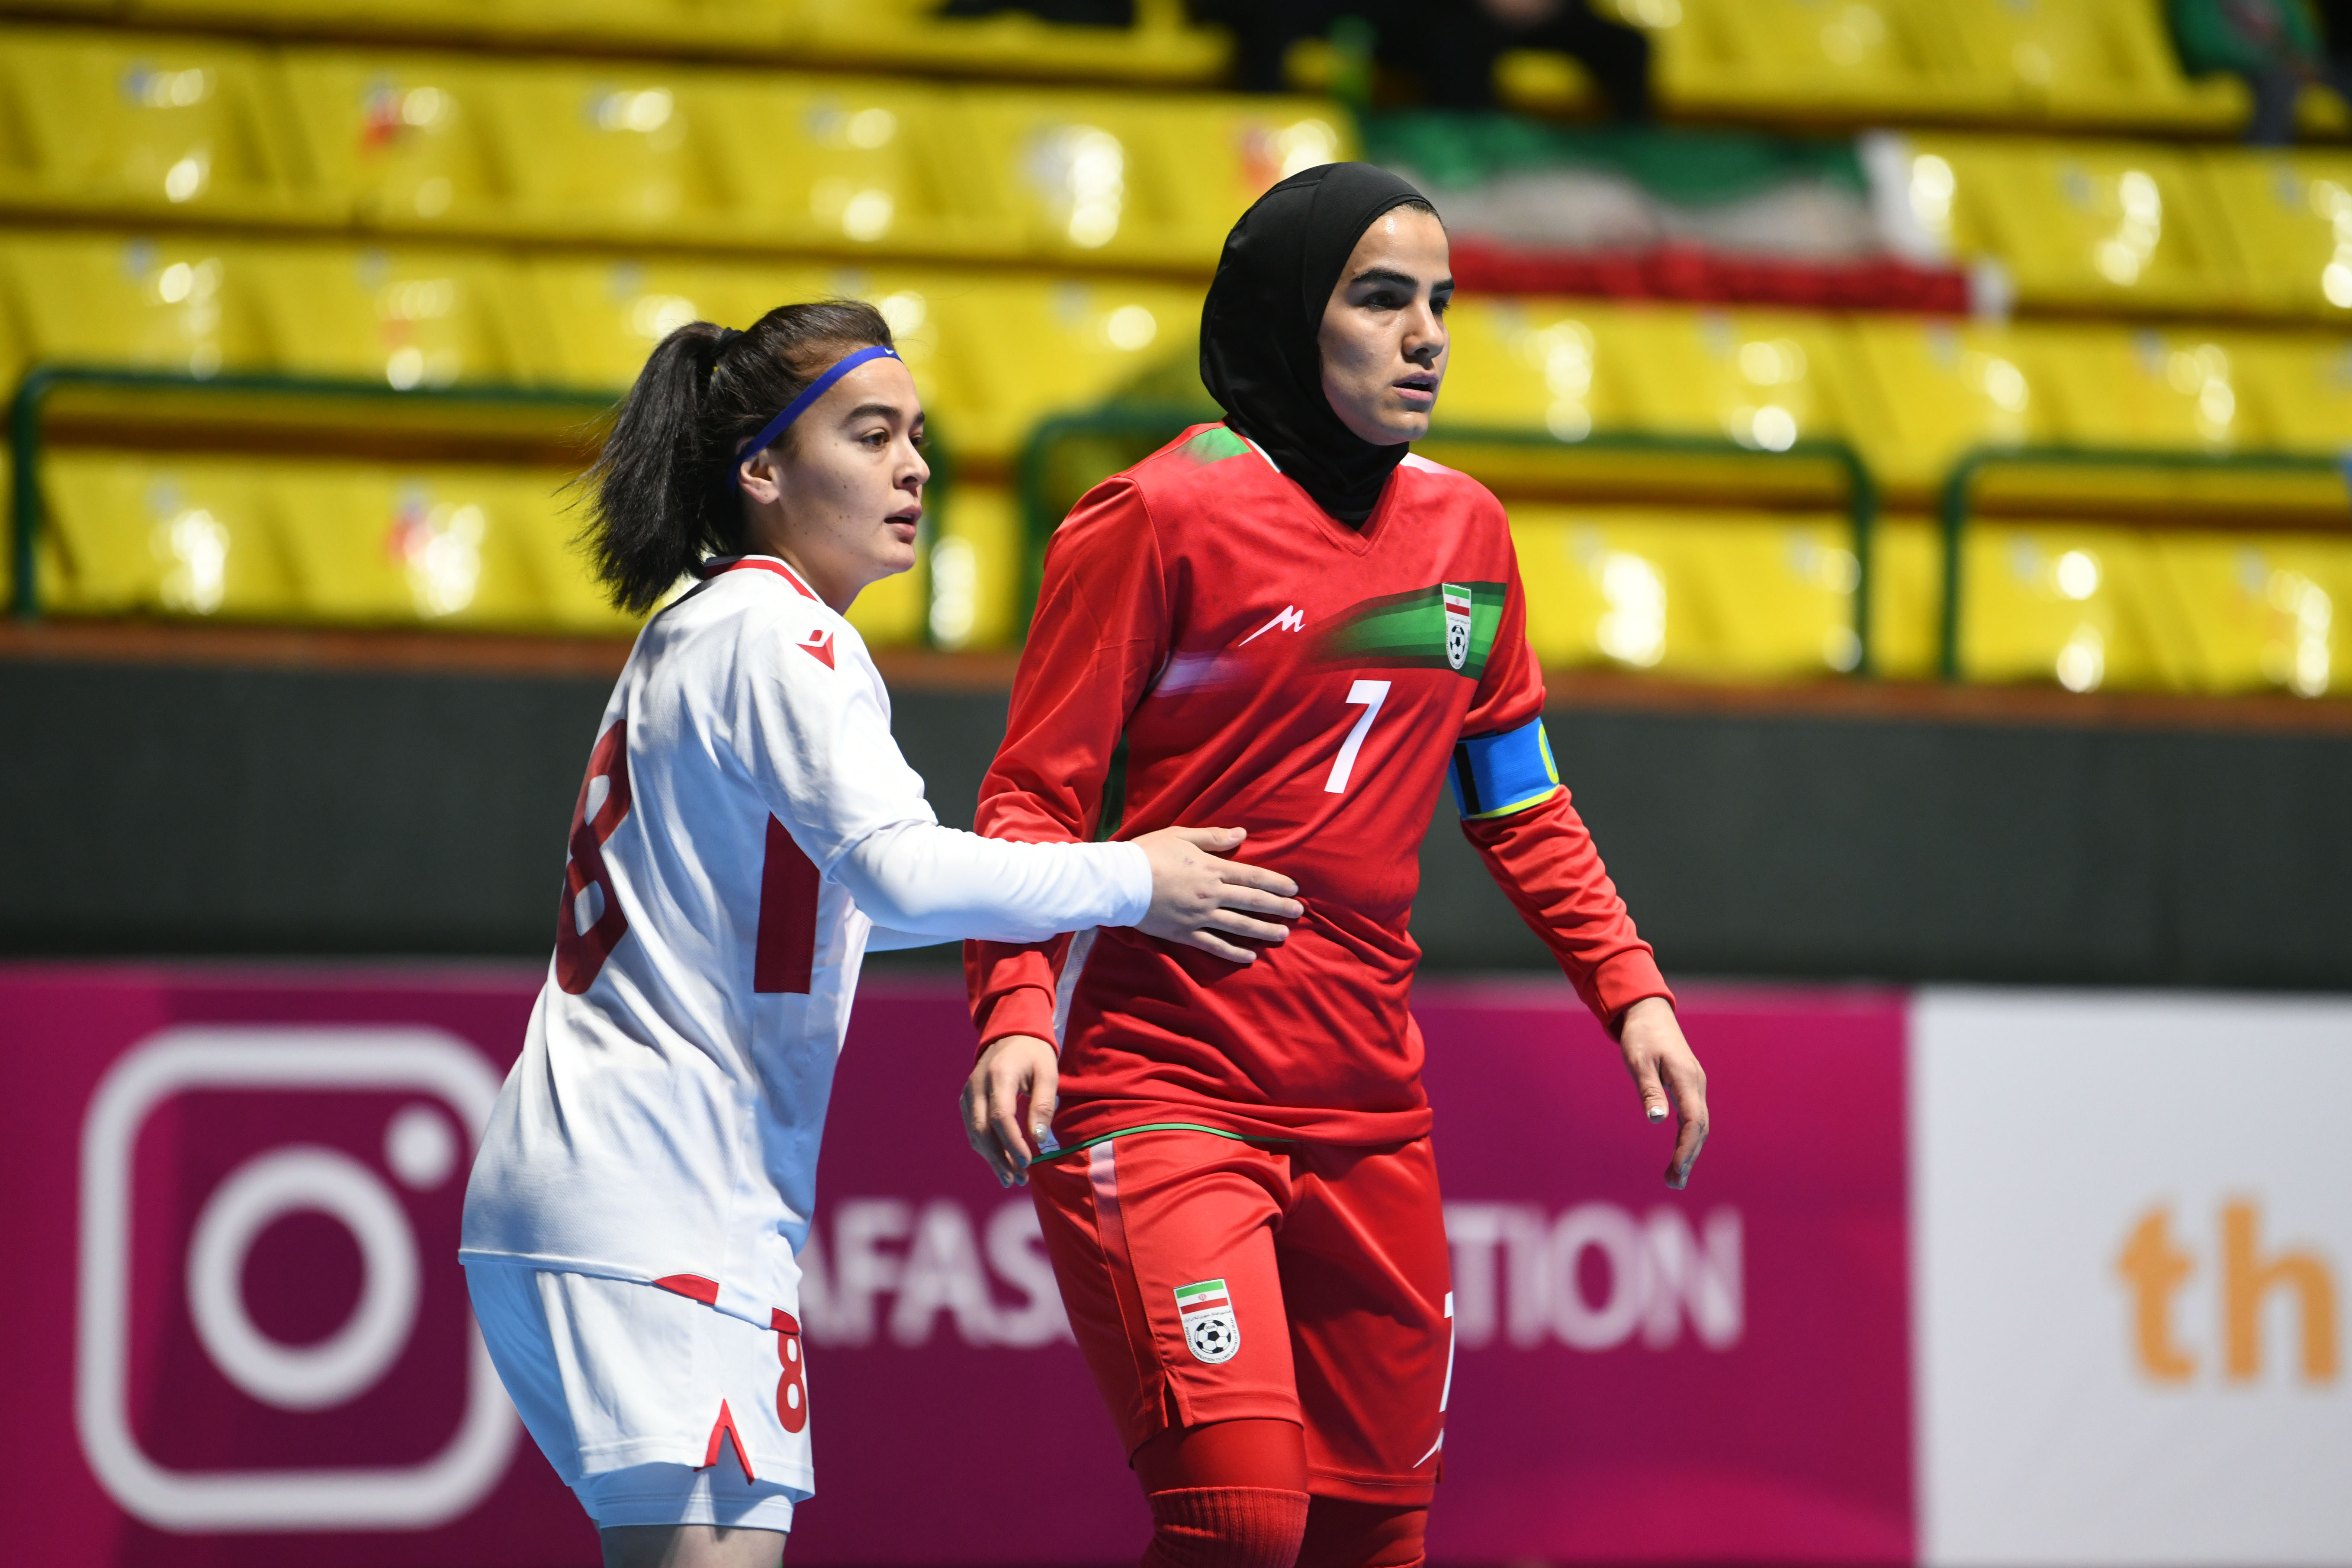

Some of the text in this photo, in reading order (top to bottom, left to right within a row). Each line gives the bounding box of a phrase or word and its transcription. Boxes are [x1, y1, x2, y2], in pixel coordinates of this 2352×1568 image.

[1324, 680, 1391, 794] 7
[556, 719, 631, 994] 8
[2117, 1201, 2340, 1385] th
[777, 1331, 806, 1433] 8
